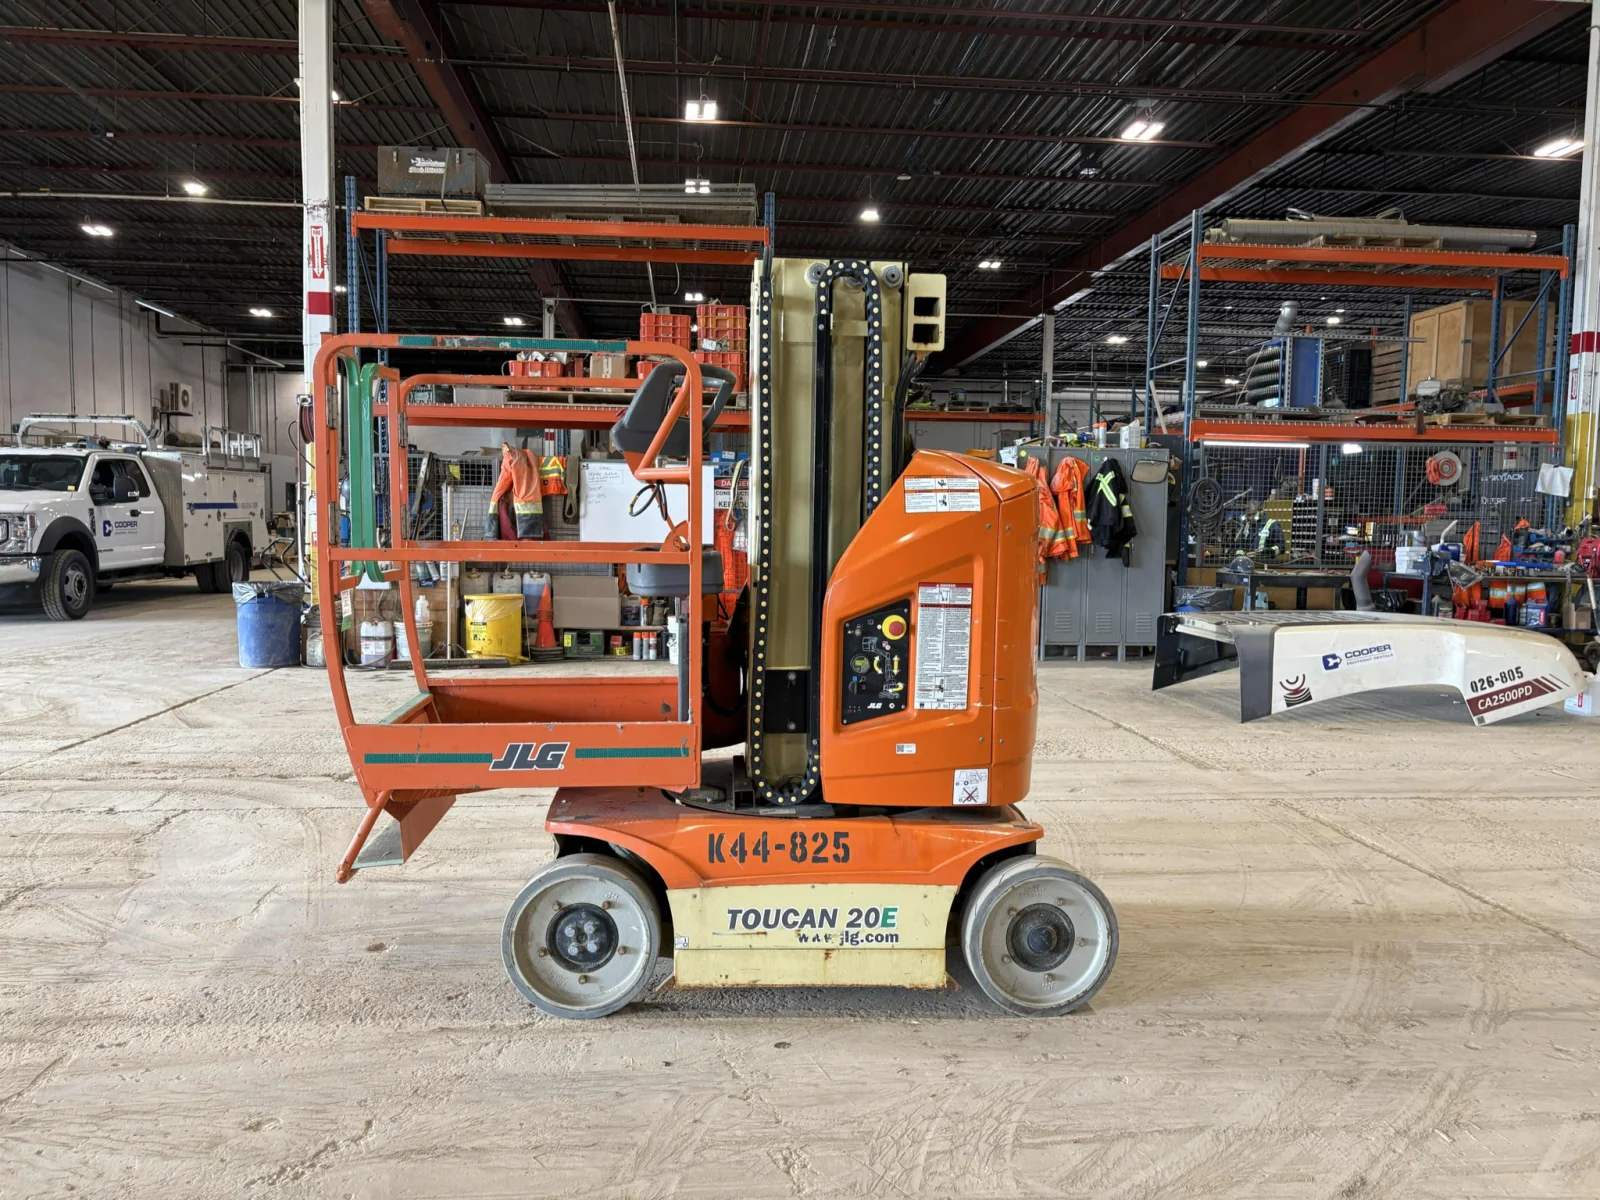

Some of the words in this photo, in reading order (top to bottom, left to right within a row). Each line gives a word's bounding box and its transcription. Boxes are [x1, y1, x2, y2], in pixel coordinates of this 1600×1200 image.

[1344, 644, 1392, 659] COOPER
[1470, 666, 1524, 693] 026-805
[1477, 685, 1533, 710] CA2500PD
[489, 742, 570, 771] JLG
[708, 831, 850, 863] K44-825
[726, 907, 838, 930] TOUCAN
[845, 907, 898, 929] 20E
